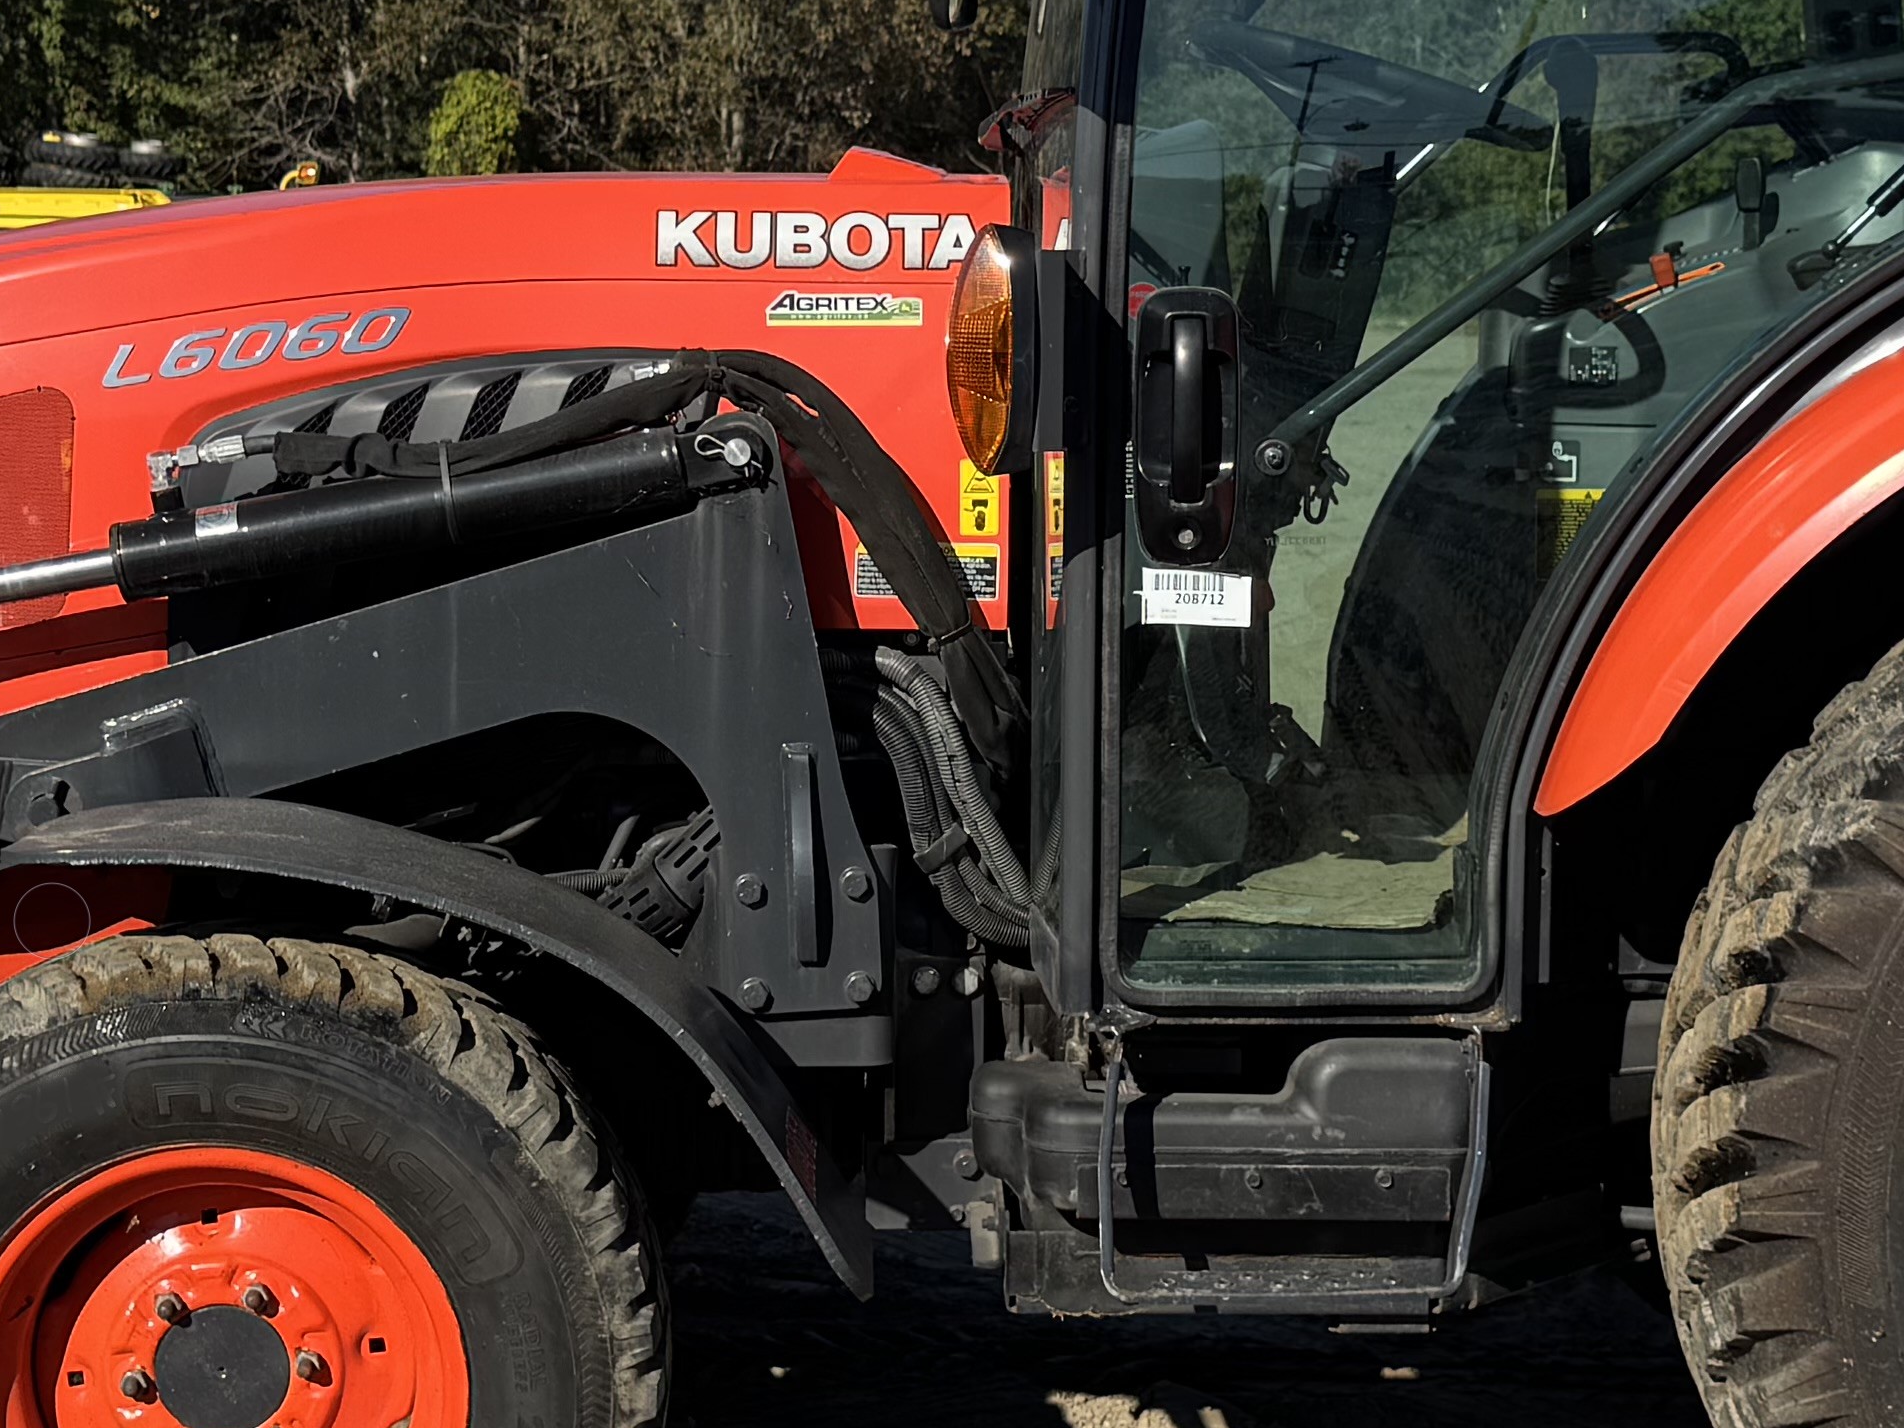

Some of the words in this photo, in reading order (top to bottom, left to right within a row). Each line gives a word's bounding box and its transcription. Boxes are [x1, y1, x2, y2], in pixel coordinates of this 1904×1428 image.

[655, 209, 976, 271] KUBOTA
[770, 293, 889, 312] AGRITEX
[101, 307, 412, 388] L6060
[1174, 593, 1225, 606] 208712
